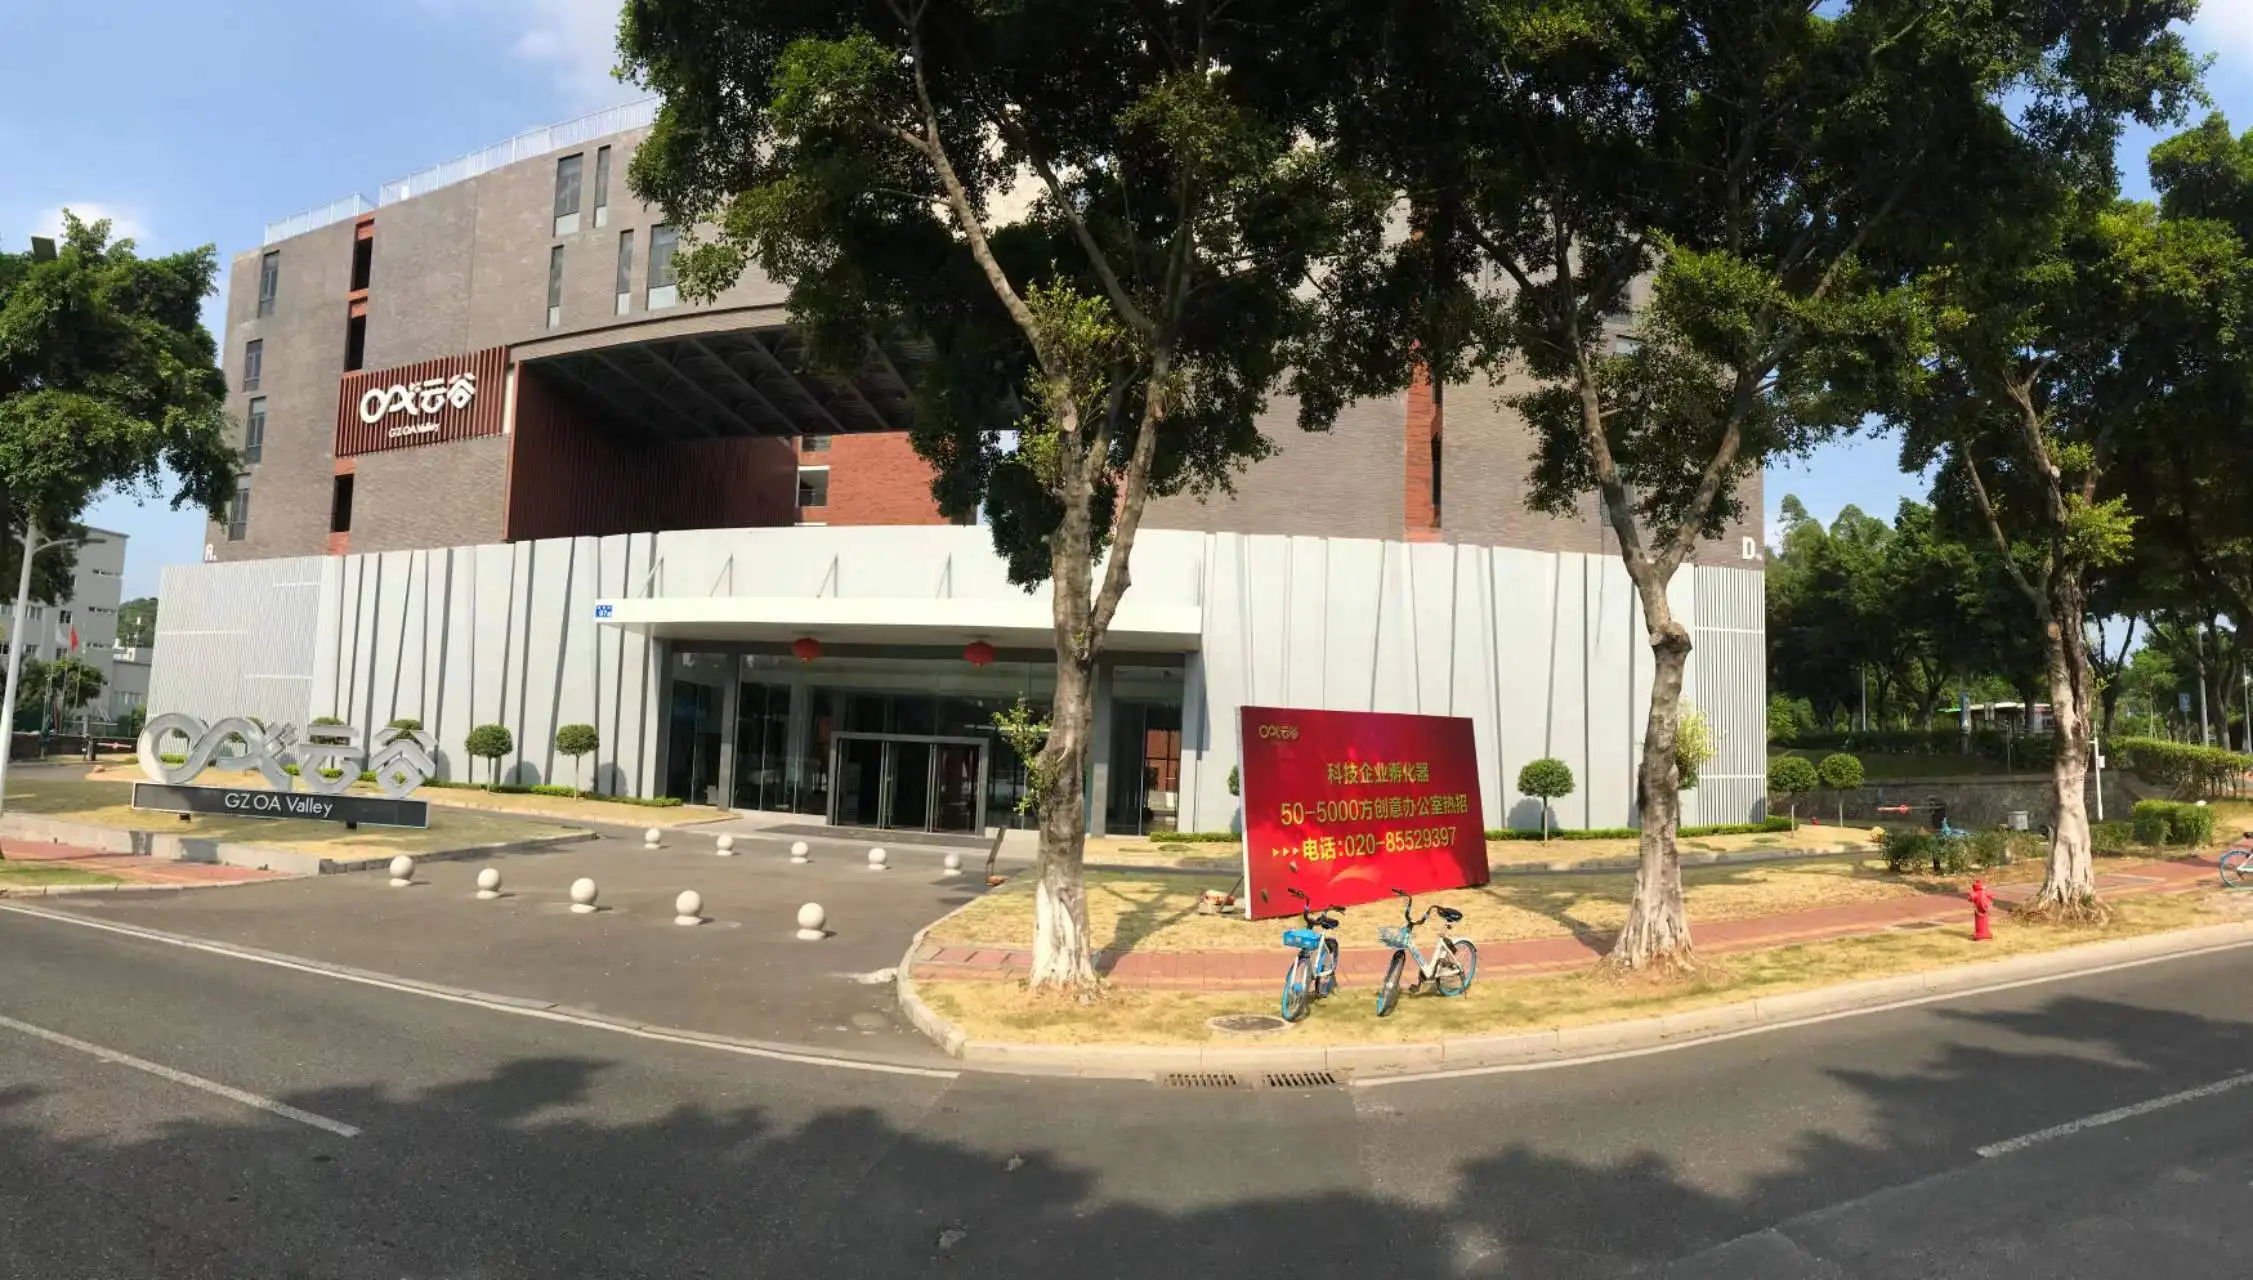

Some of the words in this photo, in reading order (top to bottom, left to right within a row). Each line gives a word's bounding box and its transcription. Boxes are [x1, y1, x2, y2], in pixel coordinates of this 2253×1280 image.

[417, 421, 440, 433] Valley
[1326, 762, 1430, 785] 科技企业孵化器
[224, 792, 251, 809] GZ
[253, 794, 281, 811] OA
[285, 795, 333, 819] Valley
[1280, 793, 1468, 826] 50-5000方创意办公室热招
